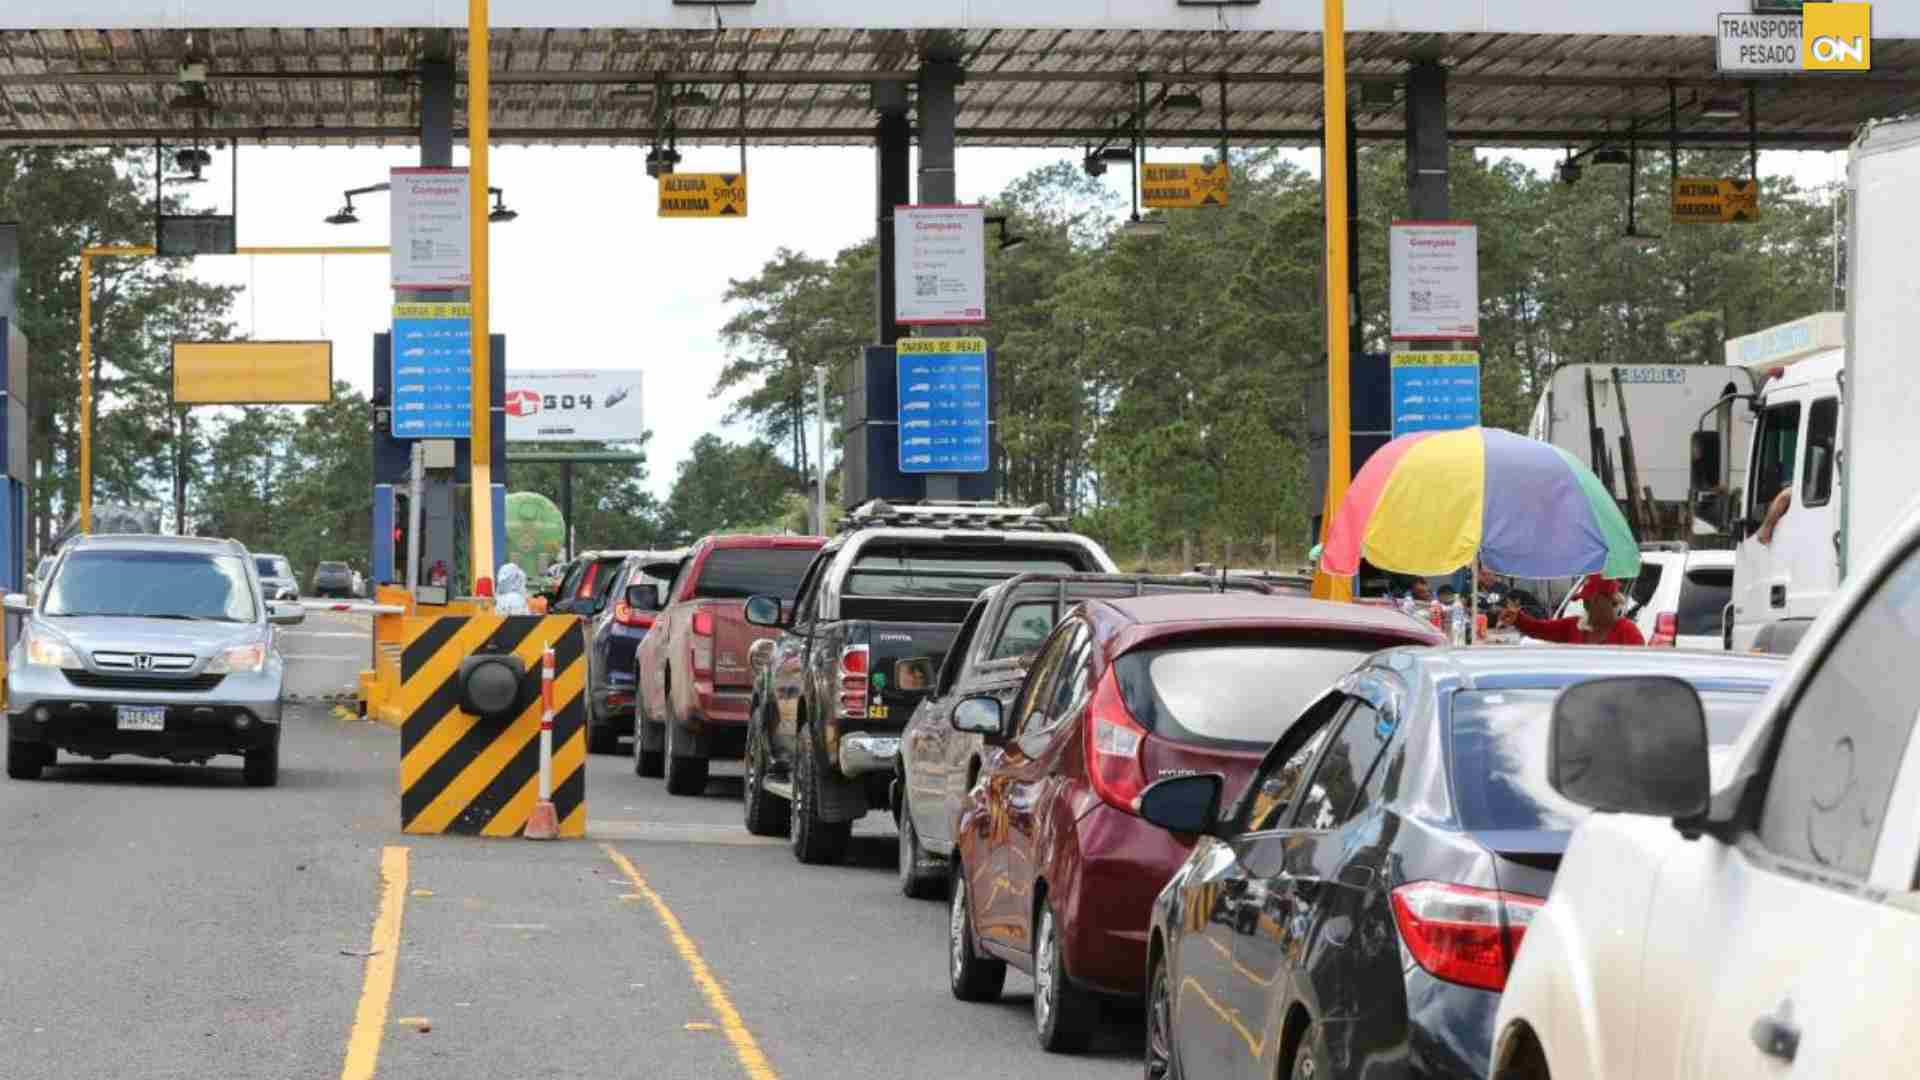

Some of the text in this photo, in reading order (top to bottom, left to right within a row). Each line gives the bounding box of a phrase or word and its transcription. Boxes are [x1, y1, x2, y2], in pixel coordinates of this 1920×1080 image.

[1740, 45, 1795, 64] PESADO
[1144, 166, 1187, 180] ALTURA
[664, 179, 706, 192] ALTURA
[661, 198, 709, 210] MAXIMA
